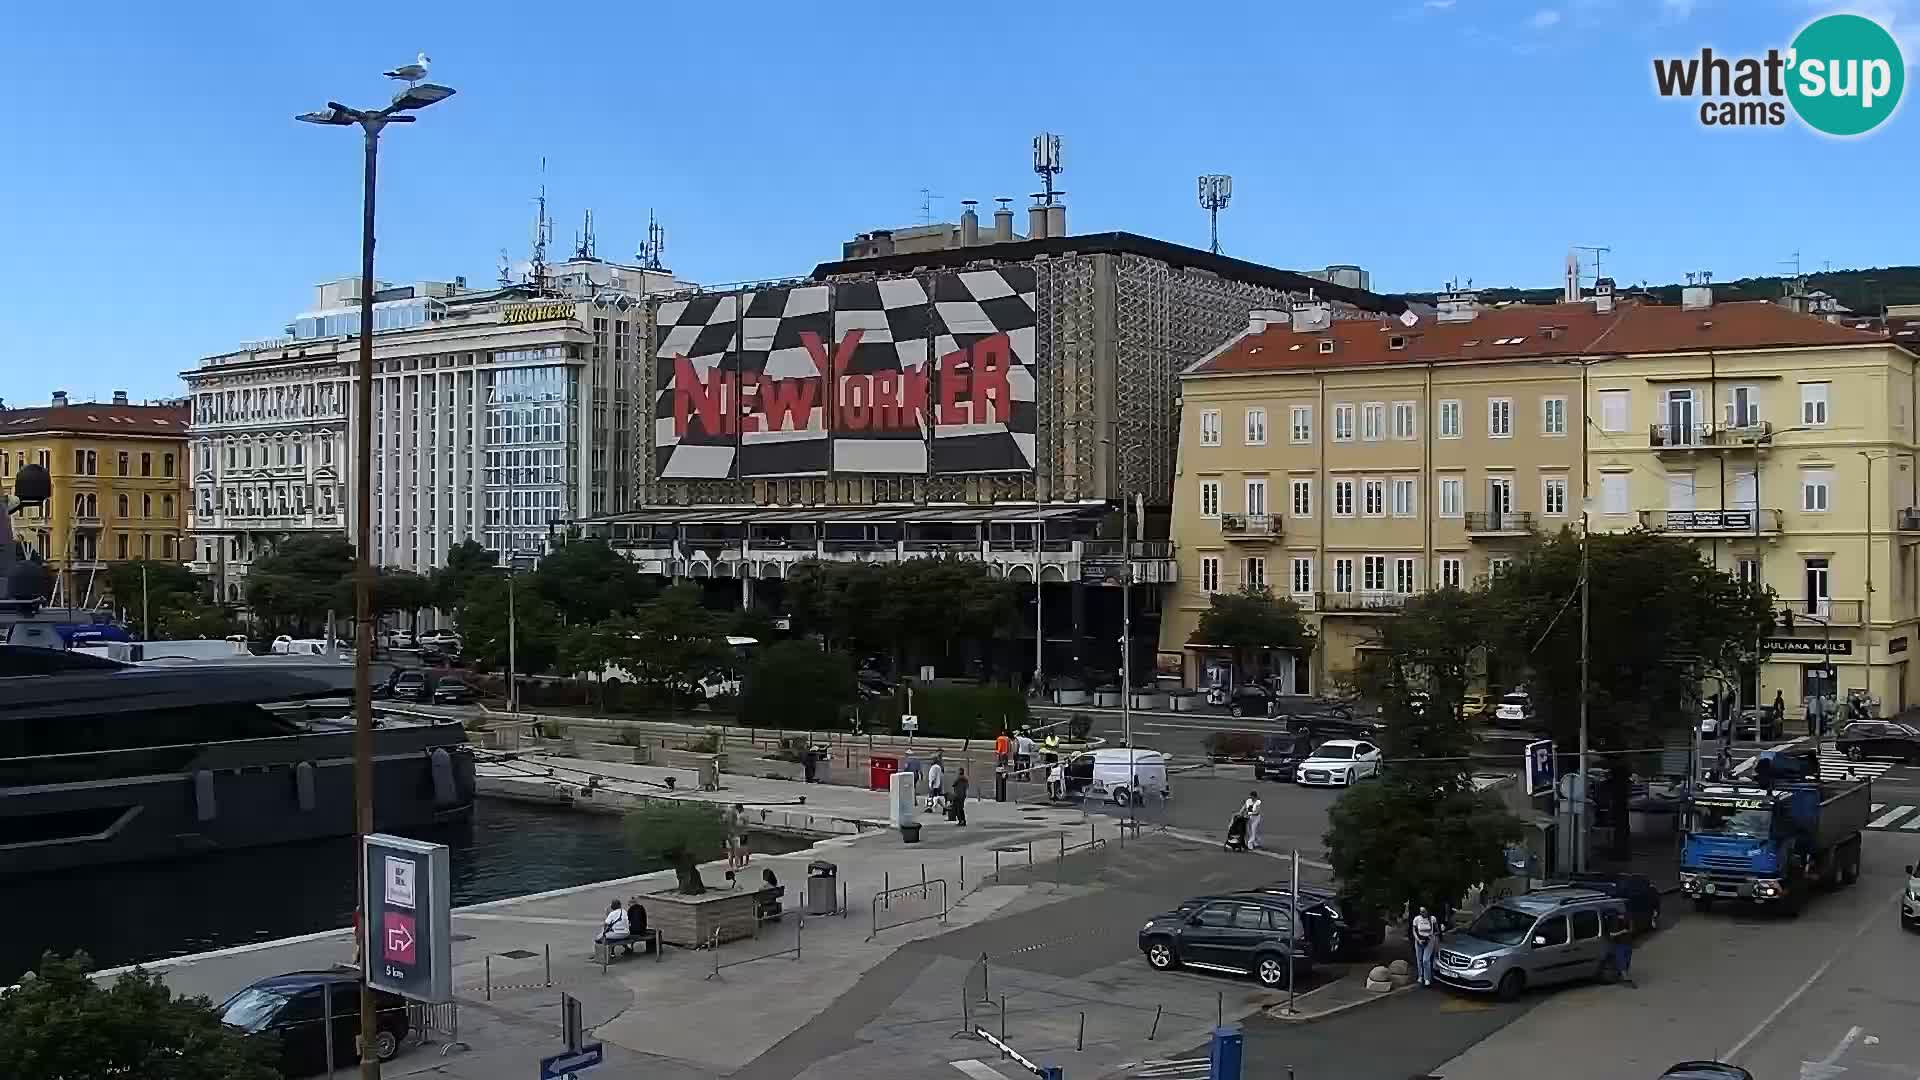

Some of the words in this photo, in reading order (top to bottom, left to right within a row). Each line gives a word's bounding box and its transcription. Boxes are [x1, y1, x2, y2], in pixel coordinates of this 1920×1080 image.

[800, 329, 1011, 434] YORKER
[1763, 641, 1810, 651] JULIANA
[1814, 643, 1846, 651] NAILS
